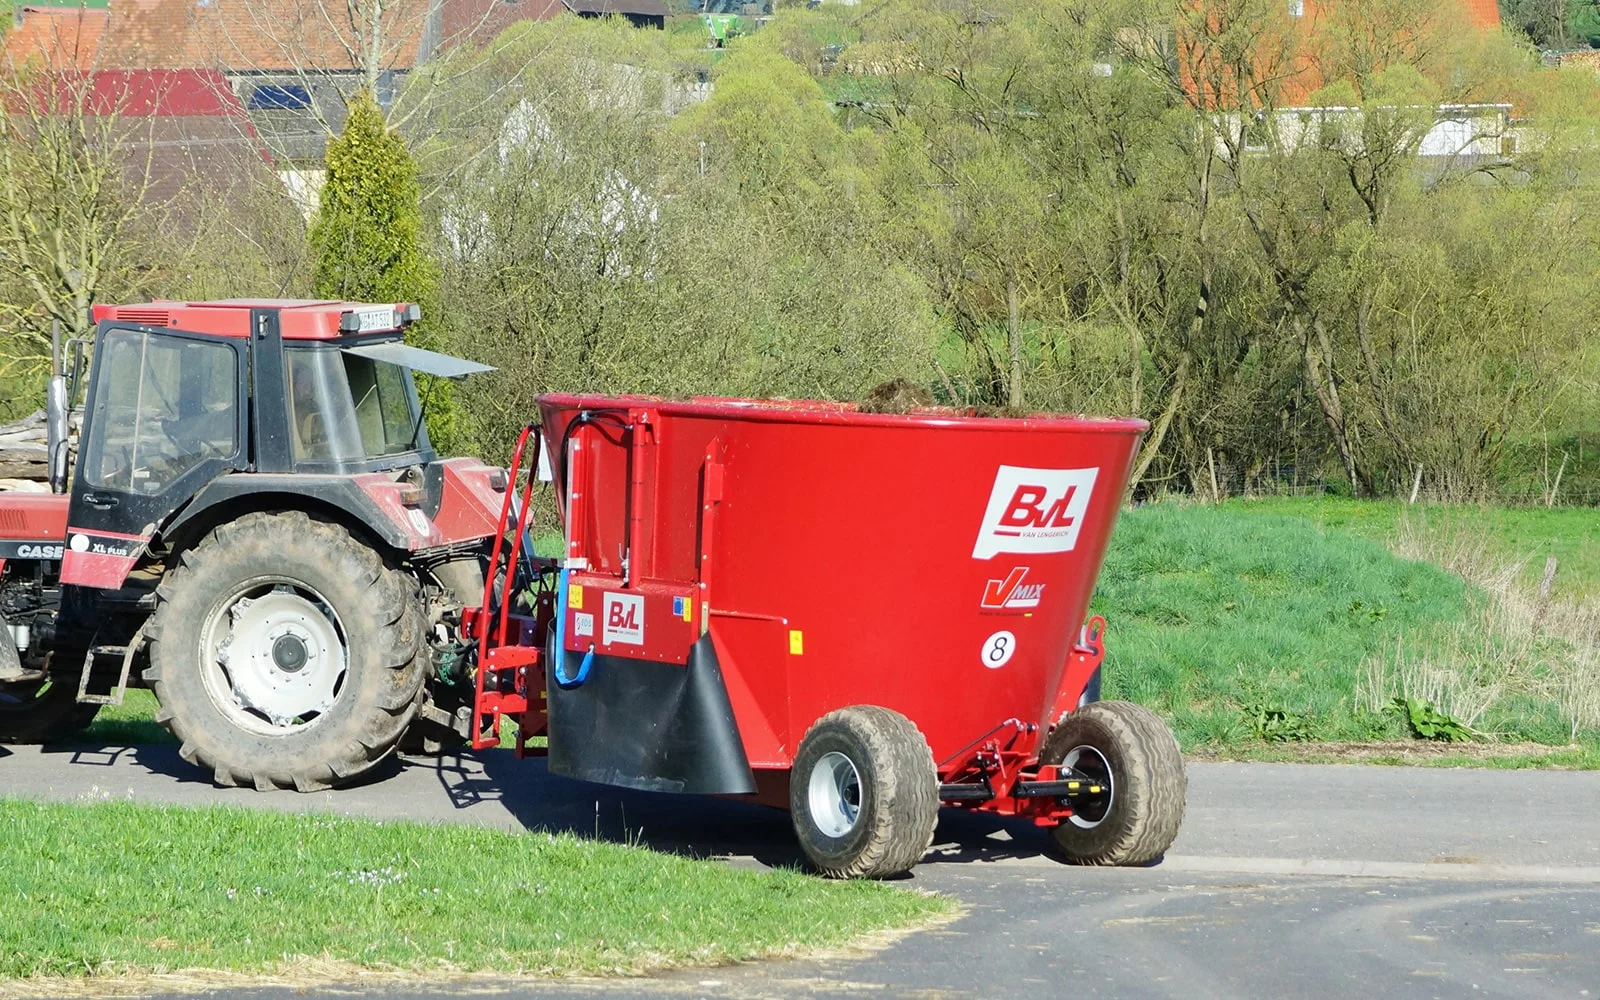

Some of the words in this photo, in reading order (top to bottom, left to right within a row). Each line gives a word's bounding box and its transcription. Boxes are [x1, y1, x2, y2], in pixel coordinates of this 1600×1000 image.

[1036, 531, 1069, 539] LENGERICH
[17, 544, 64, 558] CASE
[92, 543, 107, 554] XL
[107, 547, 128, 556] PLUS
[990, 636, 1008, 662] 8
